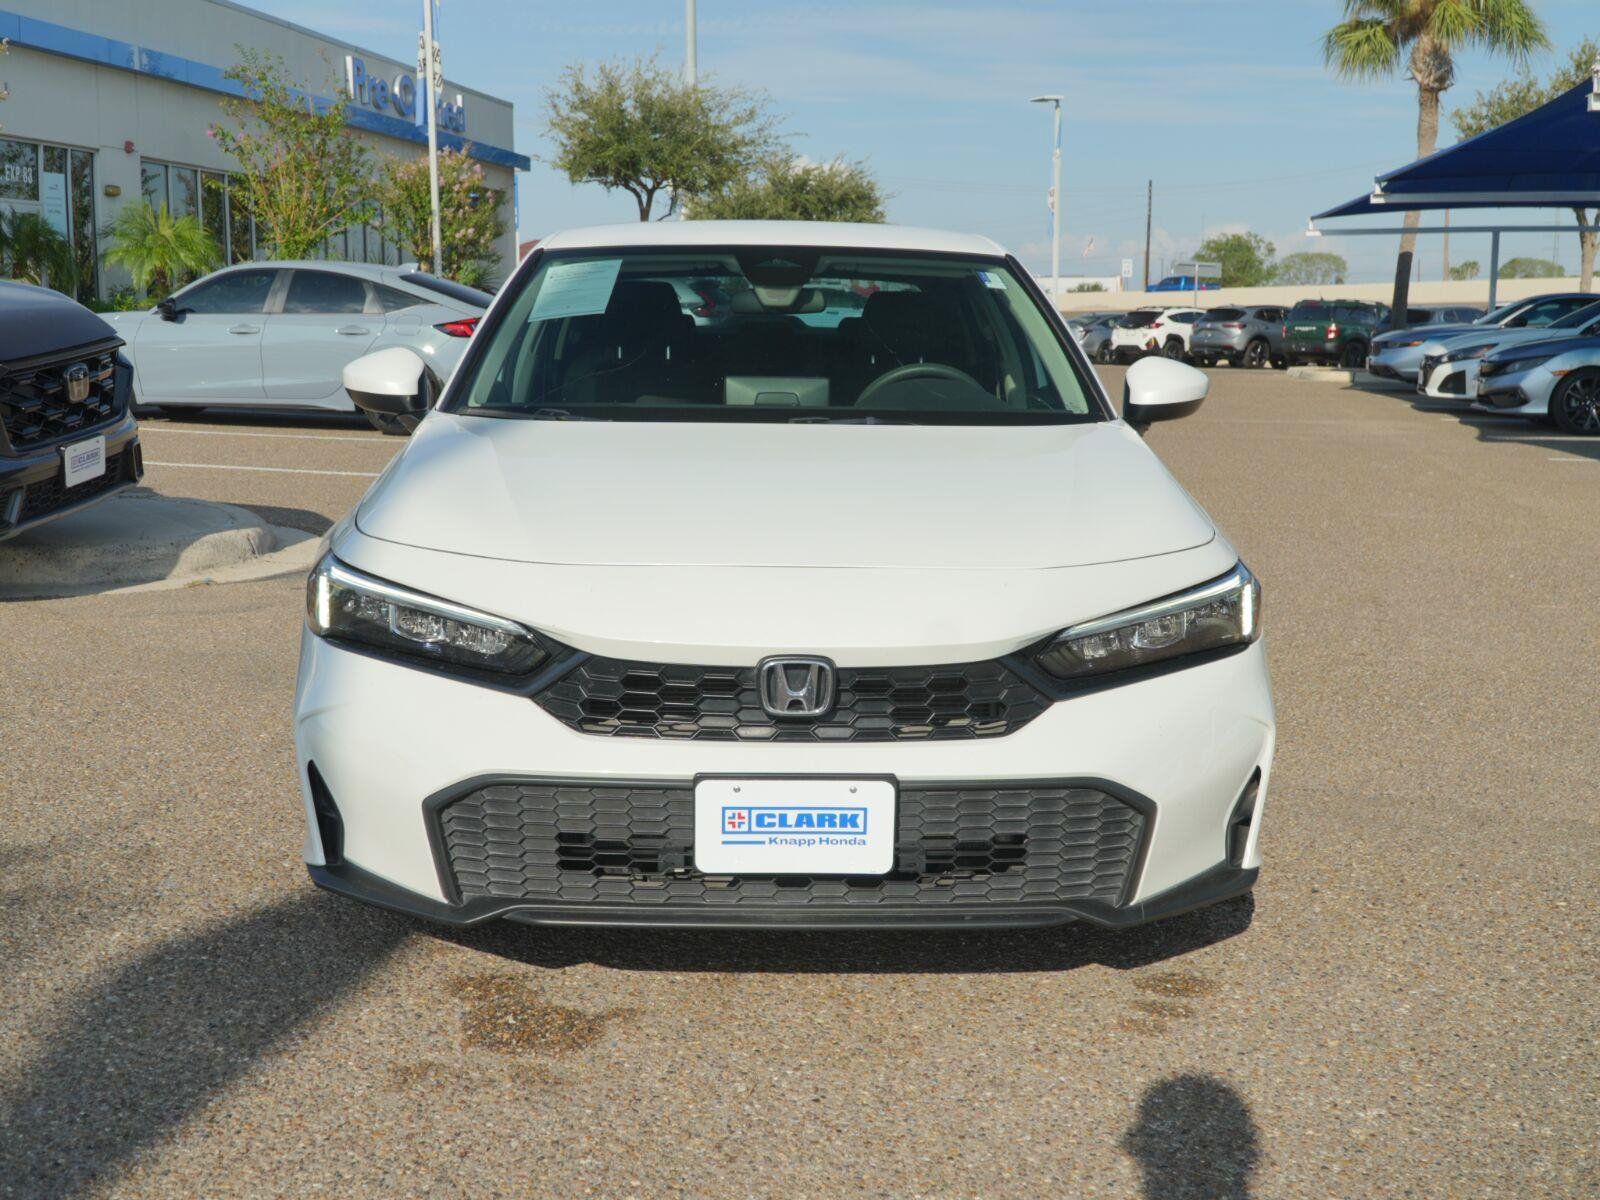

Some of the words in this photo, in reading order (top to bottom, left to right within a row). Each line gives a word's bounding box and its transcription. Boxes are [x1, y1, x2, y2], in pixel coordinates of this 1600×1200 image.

[4, 164, 20, 181] EXP
[755, 813, 860, 829] CLARK
[768, 836, 816, 847] Knapp
[819, 836, 867, 846] Honda
